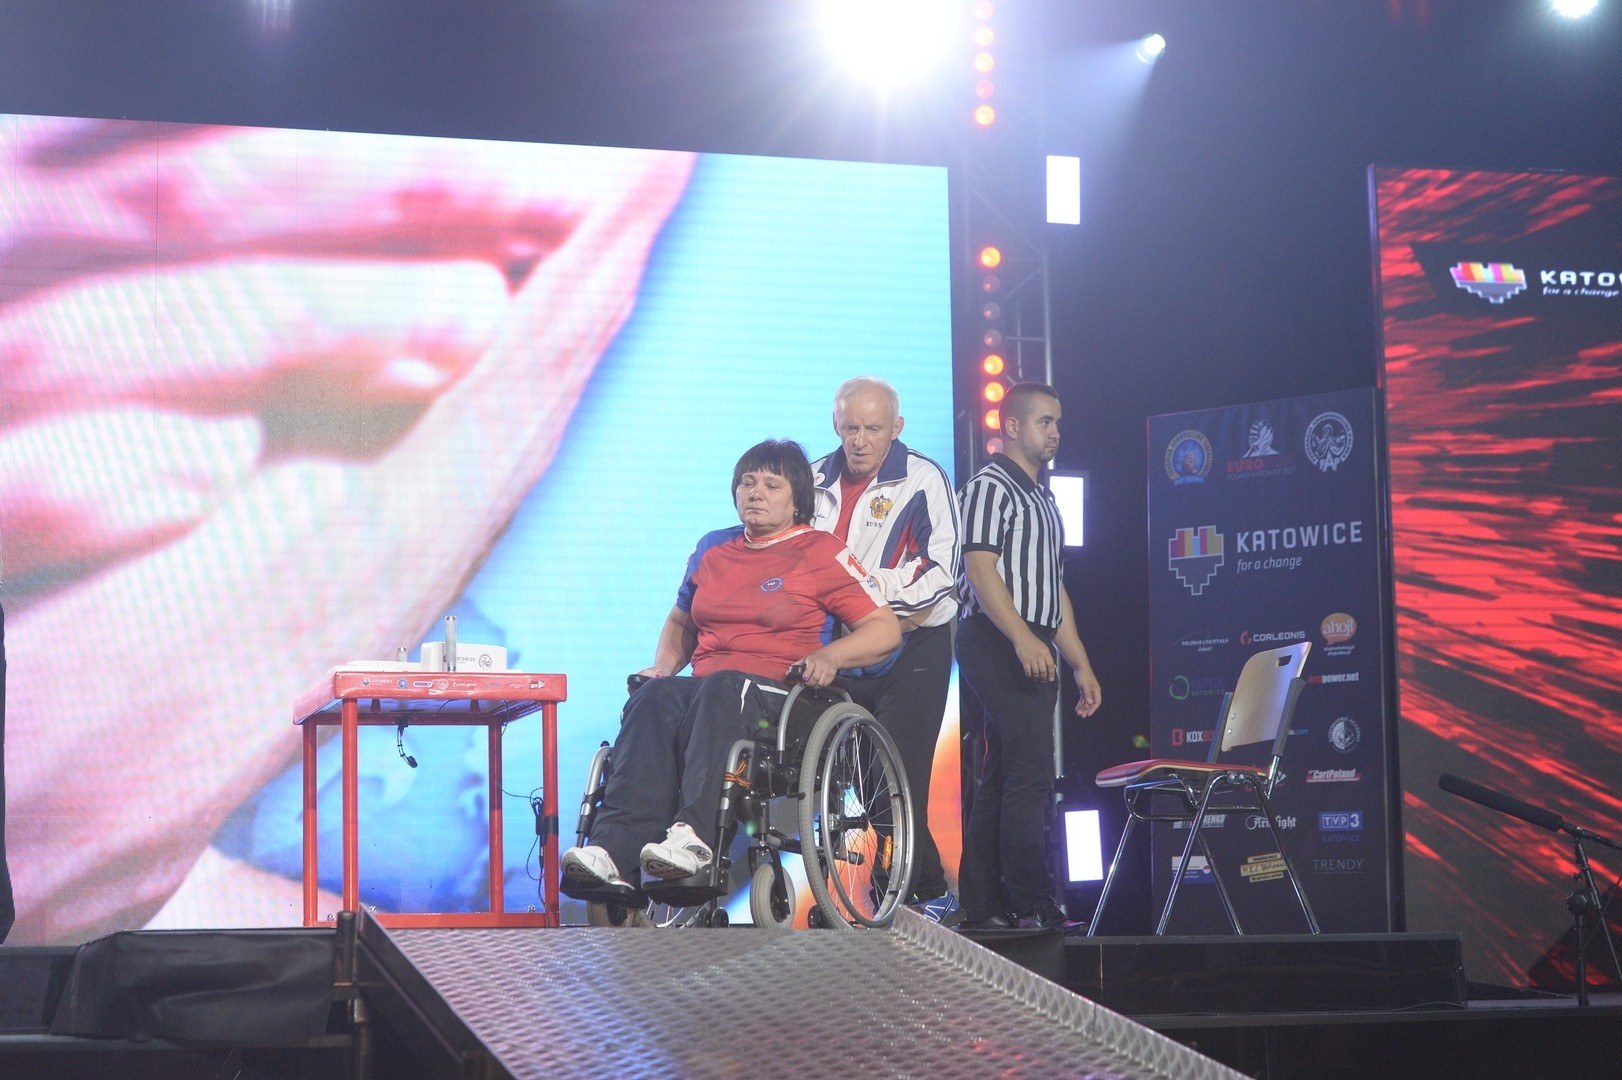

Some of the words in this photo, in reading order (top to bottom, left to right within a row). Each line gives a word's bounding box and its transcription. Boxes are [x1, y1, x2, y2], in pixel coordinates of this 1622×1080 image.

[1540, 269, 1622, 287] KATO
[1237, 521, 1363, 553] KATOWICE
[1237, 558, 1252, 574] for
[1254, 560, 1261, 570] a
[1263, 556, 1302, 573] change
[1322, 618, 1354, 636] ahoj!
[1253, 630, 1306, 642] CORLEONIS
[1308, 672, 1359, 684] armpower.net
[1186, 730, 1214, 743] KOXBO
[1323, 815, 1348, 828] TVP
[1350, 813, 1360, 828] 3
[1313, 859, 1365, 870] TRENDY
